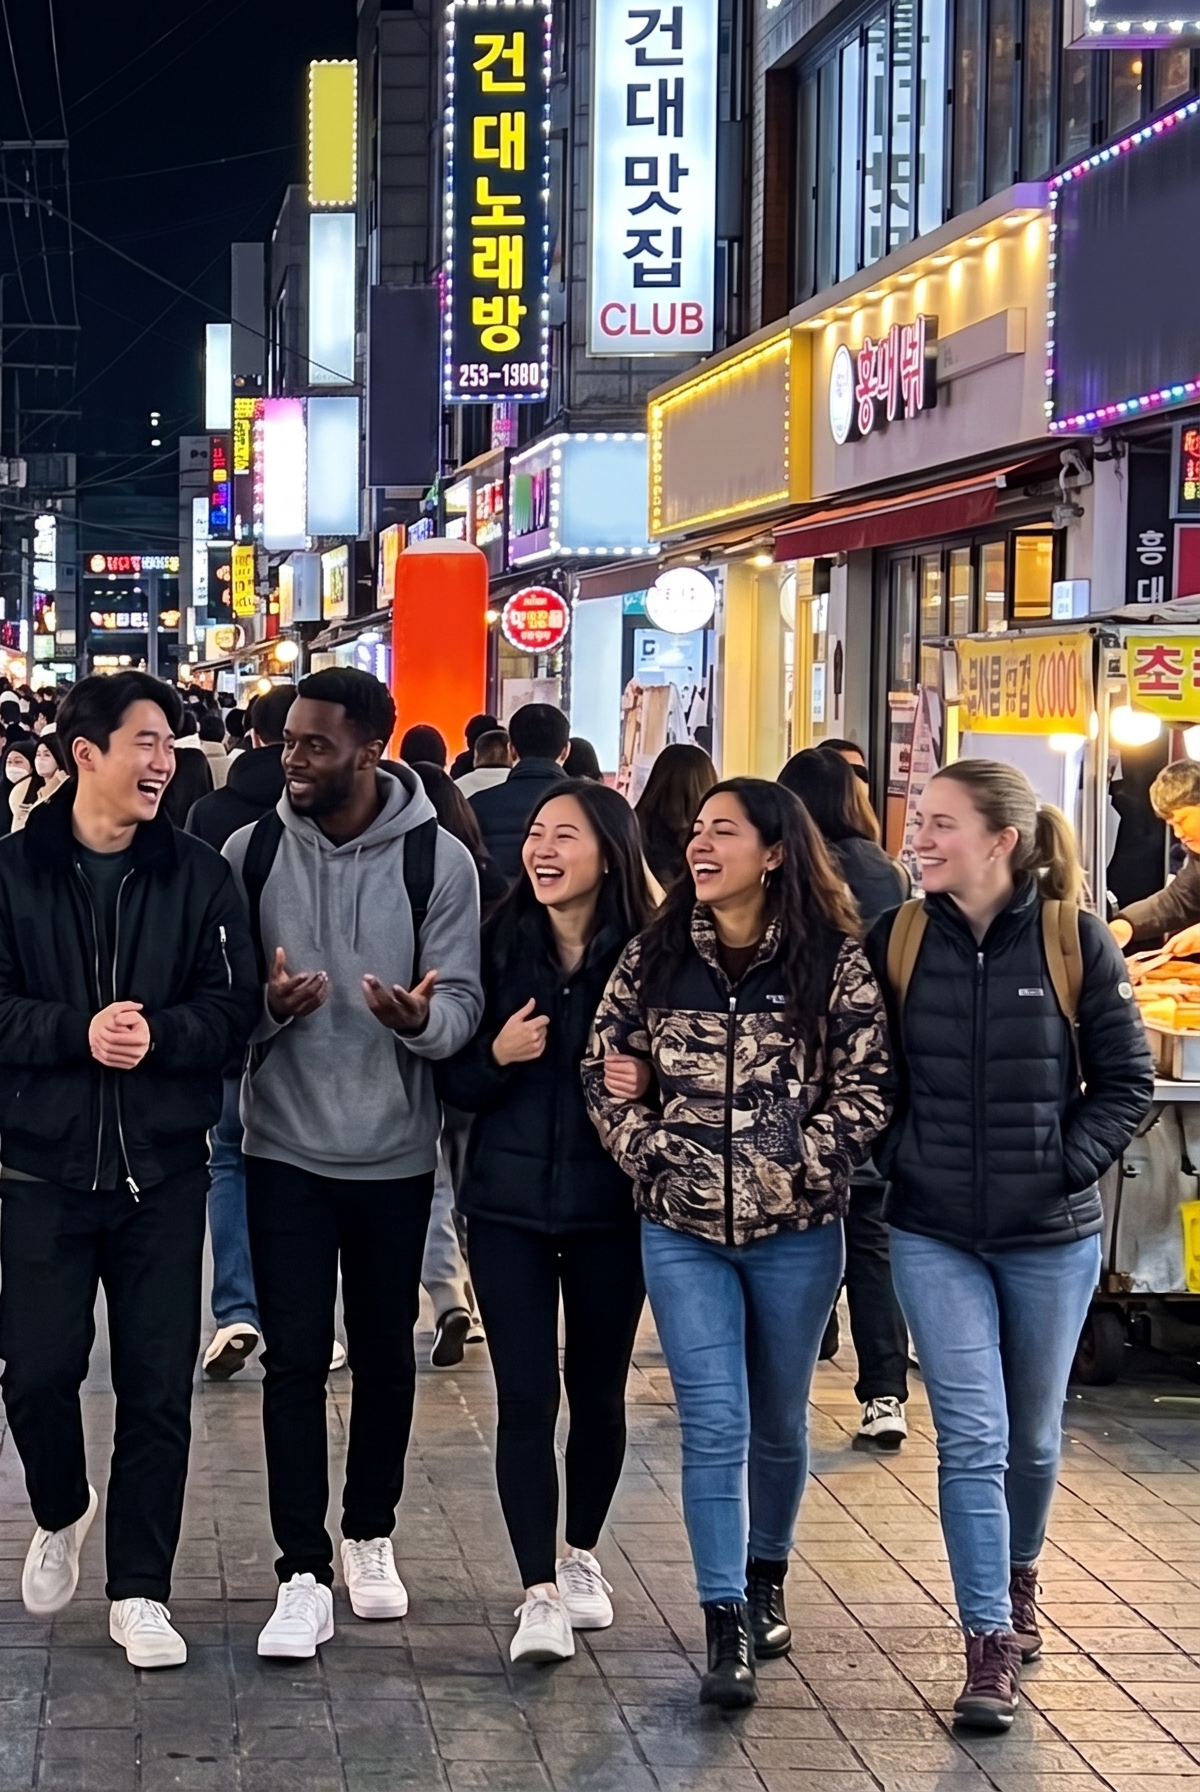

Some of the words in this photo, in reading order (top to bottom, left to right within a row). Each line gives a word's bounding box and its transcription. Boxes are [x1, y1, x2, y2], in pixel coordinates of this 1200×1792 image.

[471, 32, 527, 352] 건대노래방
[623, 6, 689, 288] 건대맛집
[459, 362, 539, 387] 253-1980
[599, 302, 705, 337] CLUB
